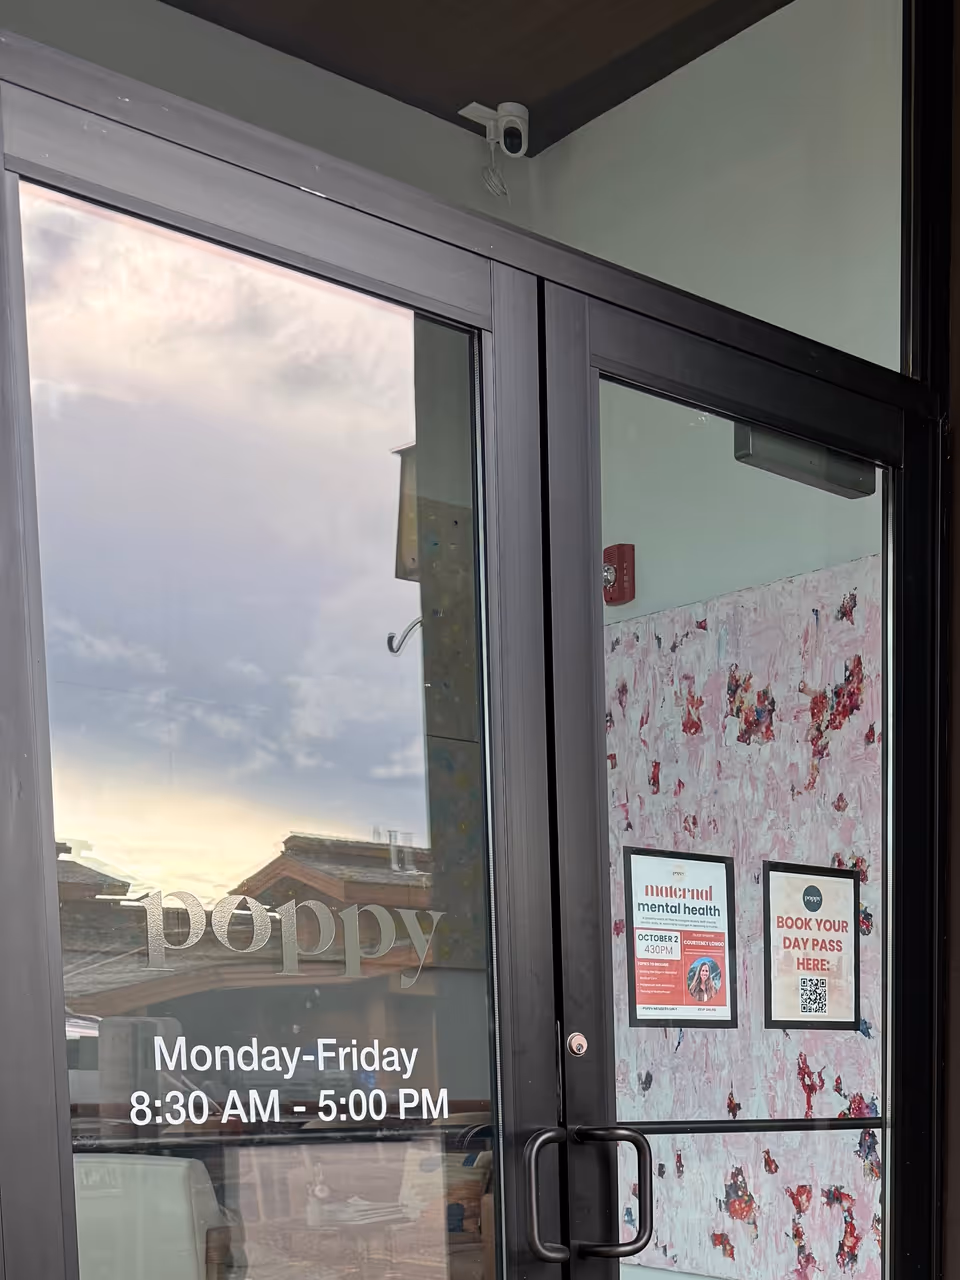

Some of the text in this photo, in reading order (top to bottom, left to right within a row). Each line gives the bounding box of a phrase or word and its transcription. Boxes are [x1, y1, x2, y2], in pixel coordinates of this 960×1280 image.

[645, 885, 712, 901] maternal
[638, 902, 721, 917] mental health
[776, 915, 849, 933] BOOK YOUR
[139, 889, 447, 989] poppy
[638, 934, 672, 943] OCTOBER
[783, 936, 843, 952] DAY PASS
[644, 945, 673, 955] 430PM
[796, 957, 830, 971] HERE:
[153, 1035, 419, 1079] Monday-Friday
[129, 1087, 450, 1126] 8:30 AM - 5:00 PM
